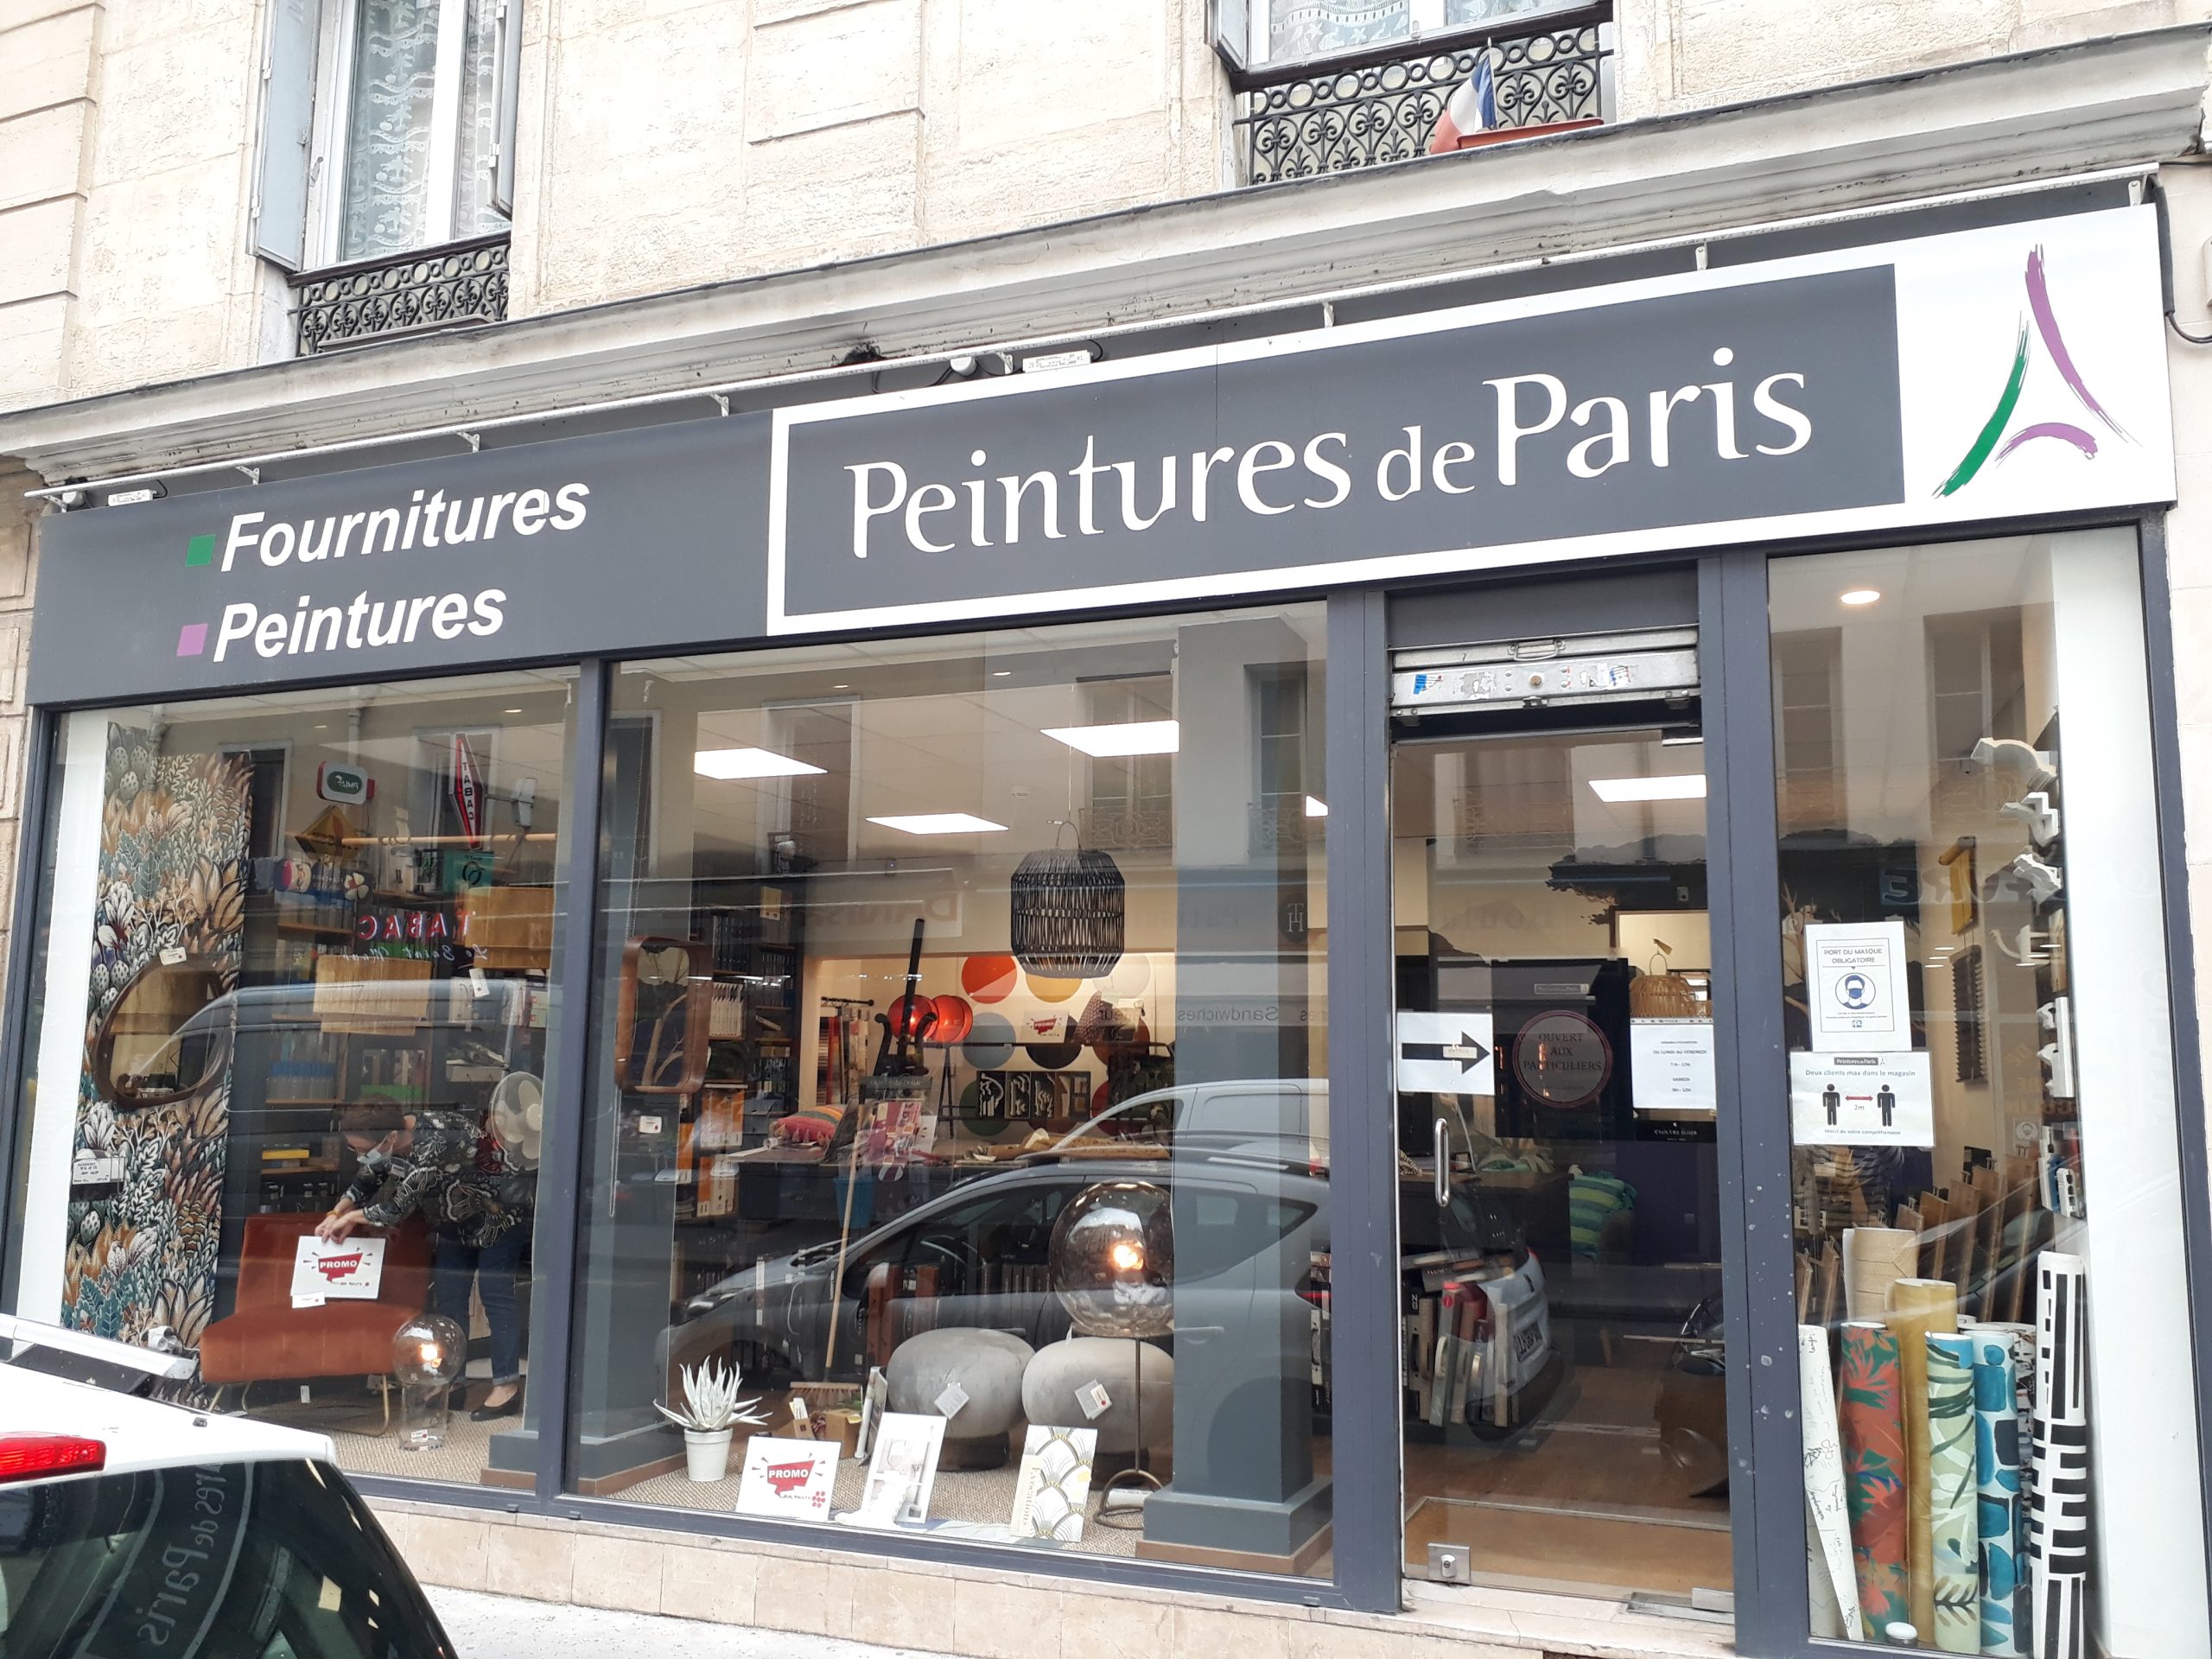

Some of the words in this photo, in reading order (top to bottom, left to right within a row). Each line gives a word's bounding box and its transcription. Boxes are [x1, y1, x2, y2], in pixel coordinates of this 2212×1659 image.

[843, 425, 1352, 560] Peintures
[1376, 425, 1476, 501] de
[1483, 346, 1813, 487] Paris
[220, 482, 590, 572] Fournitures
[213, 588, 507, 663] Peintures
[1538, 1032, 1584, 1042] OUVERT
[1550, 1046, 1573, 1056] AUX
[320, 1260, 358, 1269] PROMO
[767, 1467, 810, 1480] PROMO
